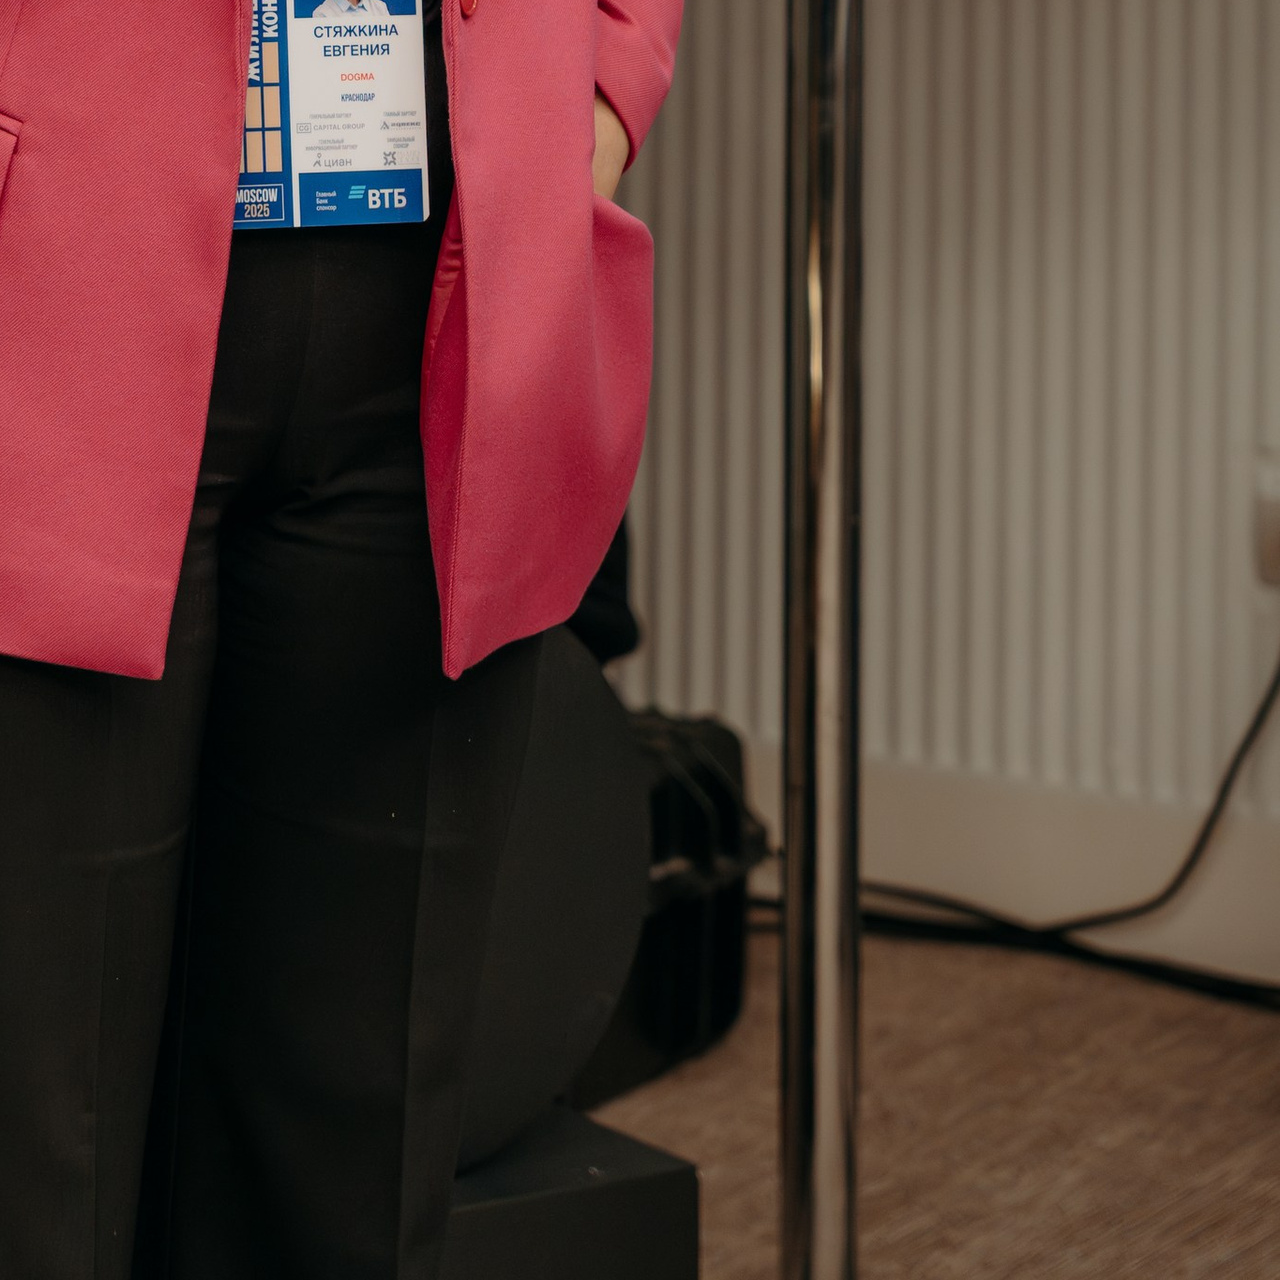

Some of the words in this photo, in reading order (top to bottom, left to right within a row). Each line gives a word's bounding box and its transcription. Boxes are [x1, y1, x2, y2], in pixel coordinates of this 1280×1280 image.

[313, 24, 399, 39] СТЯЖКИНА
[323, 43, 390, 57] ЕВГЕНИЯ
[340, 73, 375, 81] DOGMA
[340, 93, 376, 102] КРАСНОДАР
[236, 188, 278, 203] MOSCOW
[368, 188, 407, 209] ВТБ
[244, 204, 270, 218] 2025
